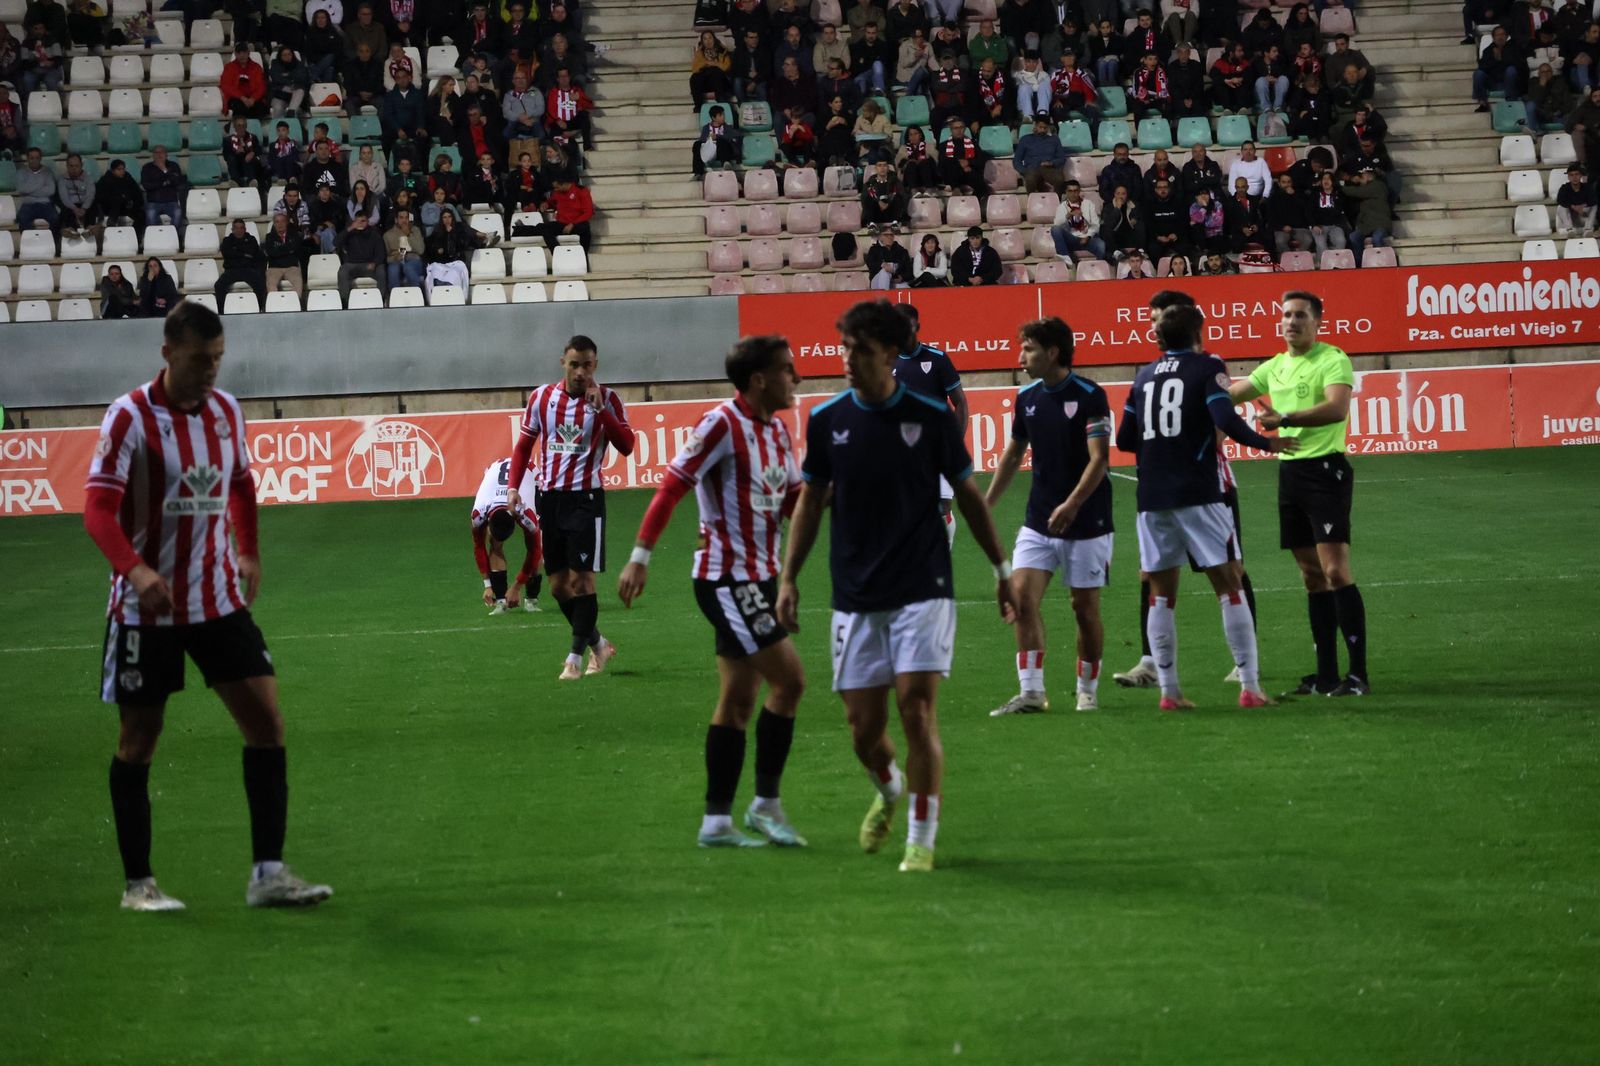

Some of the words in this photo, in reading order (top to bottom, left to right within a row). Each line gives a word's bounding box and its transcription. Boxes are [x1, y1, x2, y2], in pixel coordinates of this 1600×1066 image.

[1406, 266, 1600, 317] Saneamiento
[1208, 324, 1261, 341] DEL
[1408, 327, 1445, 341] Pza.
[1450, 323, 1516, 339] Cuartel
[1520, 321, 1566, 338] Viejo
[1571, 320, 1583, 333] 7
[945, 341, 968, 353] LA
[974, 339, 1010, 352] LUZ
[1143, 378, 1184, 440] 18
[1361, 438, 1439, 453] Zamora
[734, 582, 770, 616] 22
[126, 630, 141, 664] 9
